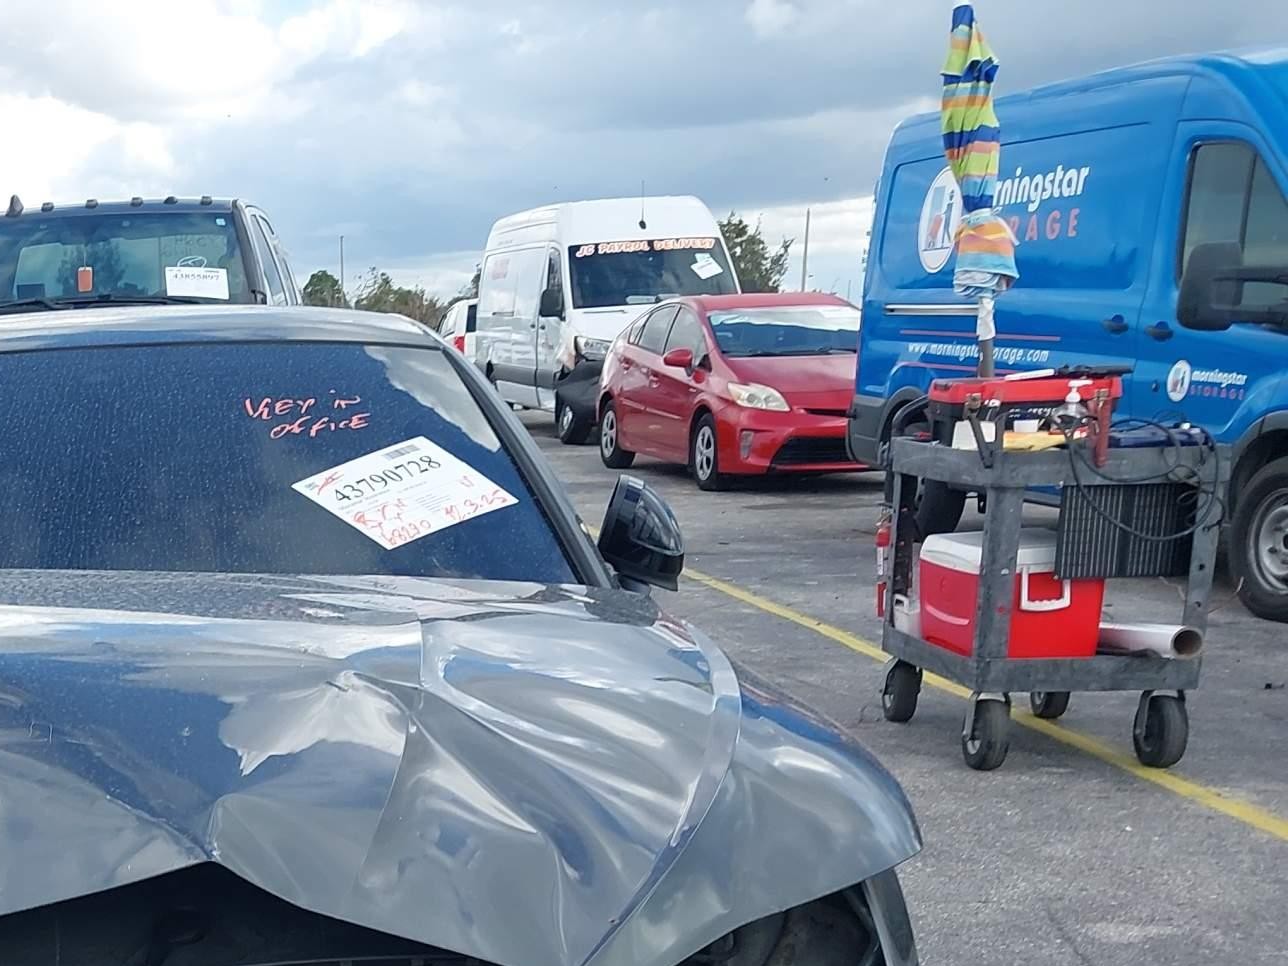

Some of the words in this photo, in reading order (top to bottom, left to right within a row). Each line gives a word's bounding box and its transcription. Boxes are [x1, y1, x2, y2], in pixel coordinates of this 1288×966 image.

[992, 164, 1090, 212] rningstar
[653, 238, 716, 251] DELIVERY
[1191, 368, 1248, 388] morningstar
[1189, 384, 1246, 401] STORAGE
[334, 455, 442, 502] 43790728
